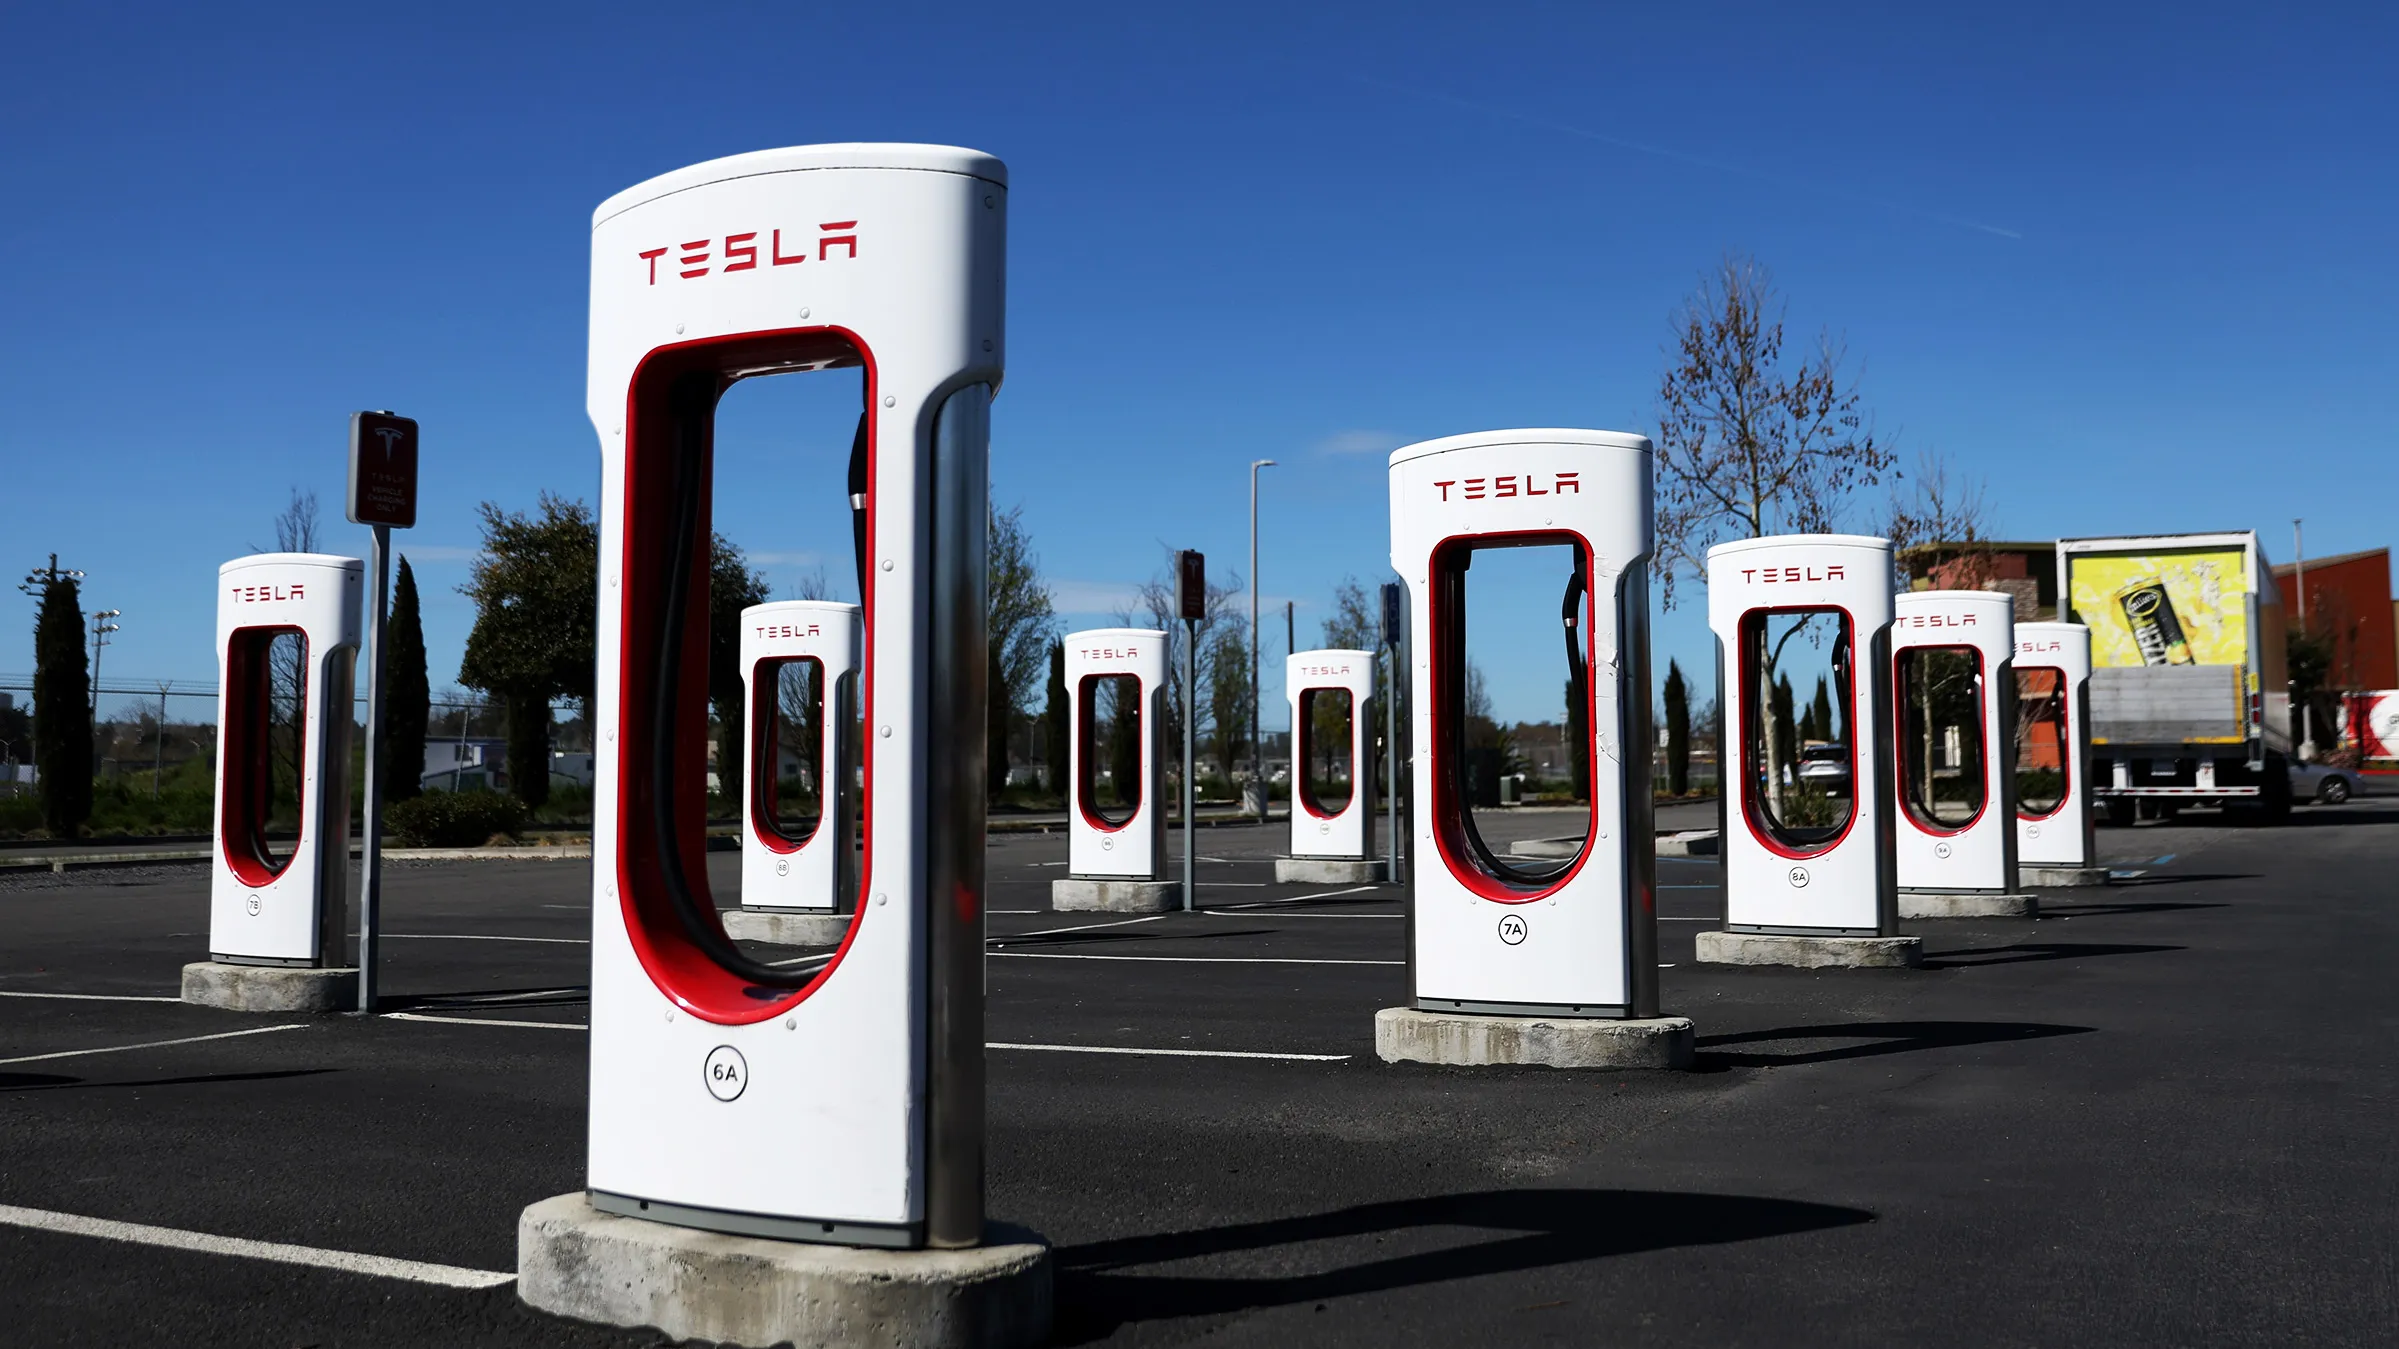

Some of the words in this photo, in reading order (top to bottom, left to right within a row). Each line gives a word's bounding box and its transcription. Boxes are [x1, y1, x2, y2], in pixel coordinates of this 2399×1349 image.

[638, 220, 859, 286] TESLA
[1433, 472, 1580, 502] TESLA
[1741, 565, 1846, 584] TESLA
[232, 584, 304, 603] TESLA
[1896, 614, 1977, 628] TESLA
[756, 624, 820, 639] TESLA
[1081, 648, 1137, 659] TESLA
[2014, 641, 2060, 652] SLA
[1301, 665, 1350, 676] TESLA
[1792, 872, 1807, 881] 8A
[249, 900, 259, 910] 7B
[1504, 923, 1523, 936] 7A
[713, 1062, 739, 1082] 6A
